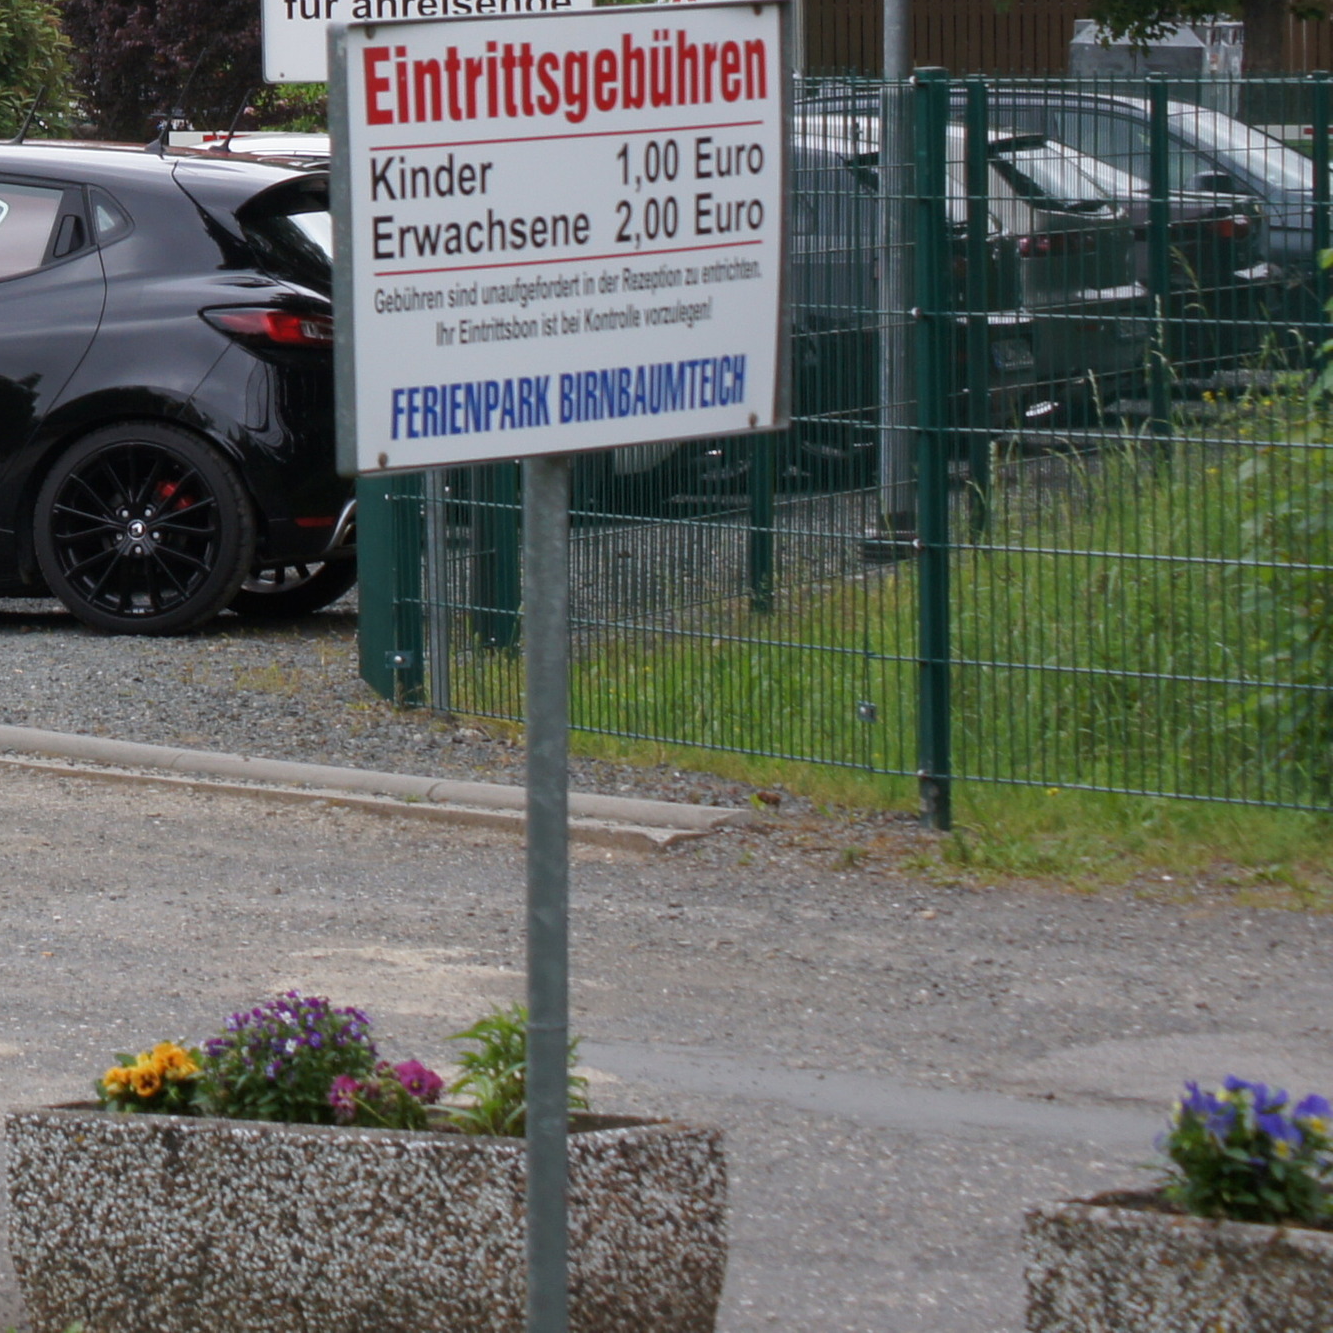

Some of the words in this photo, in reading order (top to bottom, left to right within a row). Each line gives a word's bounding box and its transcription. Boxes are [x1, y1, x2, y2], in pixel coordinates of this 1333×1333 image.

[362, 29, 767, 126] Eintrittsgebühren
[370, 152, 493, 201] Kinder
[616, 139, 679, 192] 1,00
[694, 137, 763, 179] Euro
[373, 208, 590, 260] Erwachsene
[615, 196, 679, 250] 2,00
[694, 193, 763, 236] Euro
[374, 282, 443, 314] Gebühren
[447, 281, 478, 307] sind
[482, 273, 580, 308] unaufgefordert
[583, 272, 595, 295] in
[598, 269, 618, 294] der
[622, 264, 681, 294] Rezeption
[684, 268, 699, 287] zu
[702, 258, 763, 283] entrichten.
[436, 320, 454, 346] Ihr
[459, 313, 539, 344] Eintrittsbon
[541, 313, 557, 337] ist
[561, 310, 580, 336] bei
[584, 304, 640, 332] Kontrolle
[644, 296, 713, 330] vorzulegen!
[391, 375, 552, 440] FERIENPARK
[559, 354, 747, 424] BIRNBAUMTEICH
